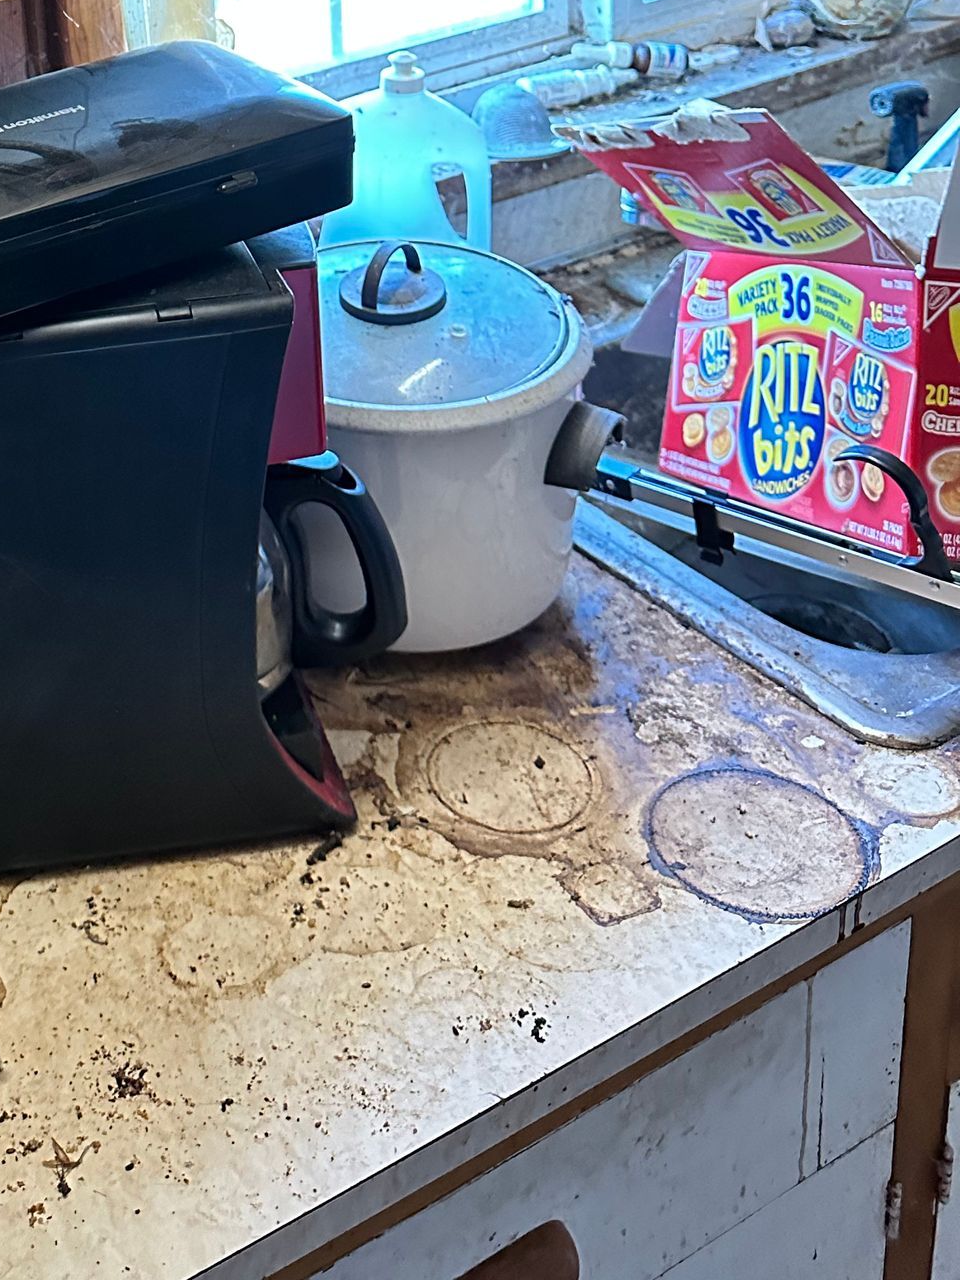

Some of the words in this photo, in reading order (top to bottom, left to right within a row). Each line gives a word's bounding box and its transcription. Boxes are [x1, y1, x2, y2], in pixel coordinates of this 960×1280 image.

[3, 104, 85, 131] Hamilton
[726, 208, 790, 247] 36
[784, 229, 816, 244] PACK
[811, 214, 853, 240] VARIETY
[737, 278, 777, 307] VARIETY
[780, 272, 811, 321] 36
[754, 297, 778, 319] PACK
[869, 301, 883, 322] 16
[852, 352, 883, 392] RITZ
[748, 341, 820, 429] RITZ
[925, 383, 948, 407] 20
[855, 387, 880, 411] bits
[753, 421, 816, 477] bits
[752, 470, 811, 495] SANDWICHES
[943, 533, 952, 545] OZ
[946, 546, 956, 557] OZ
